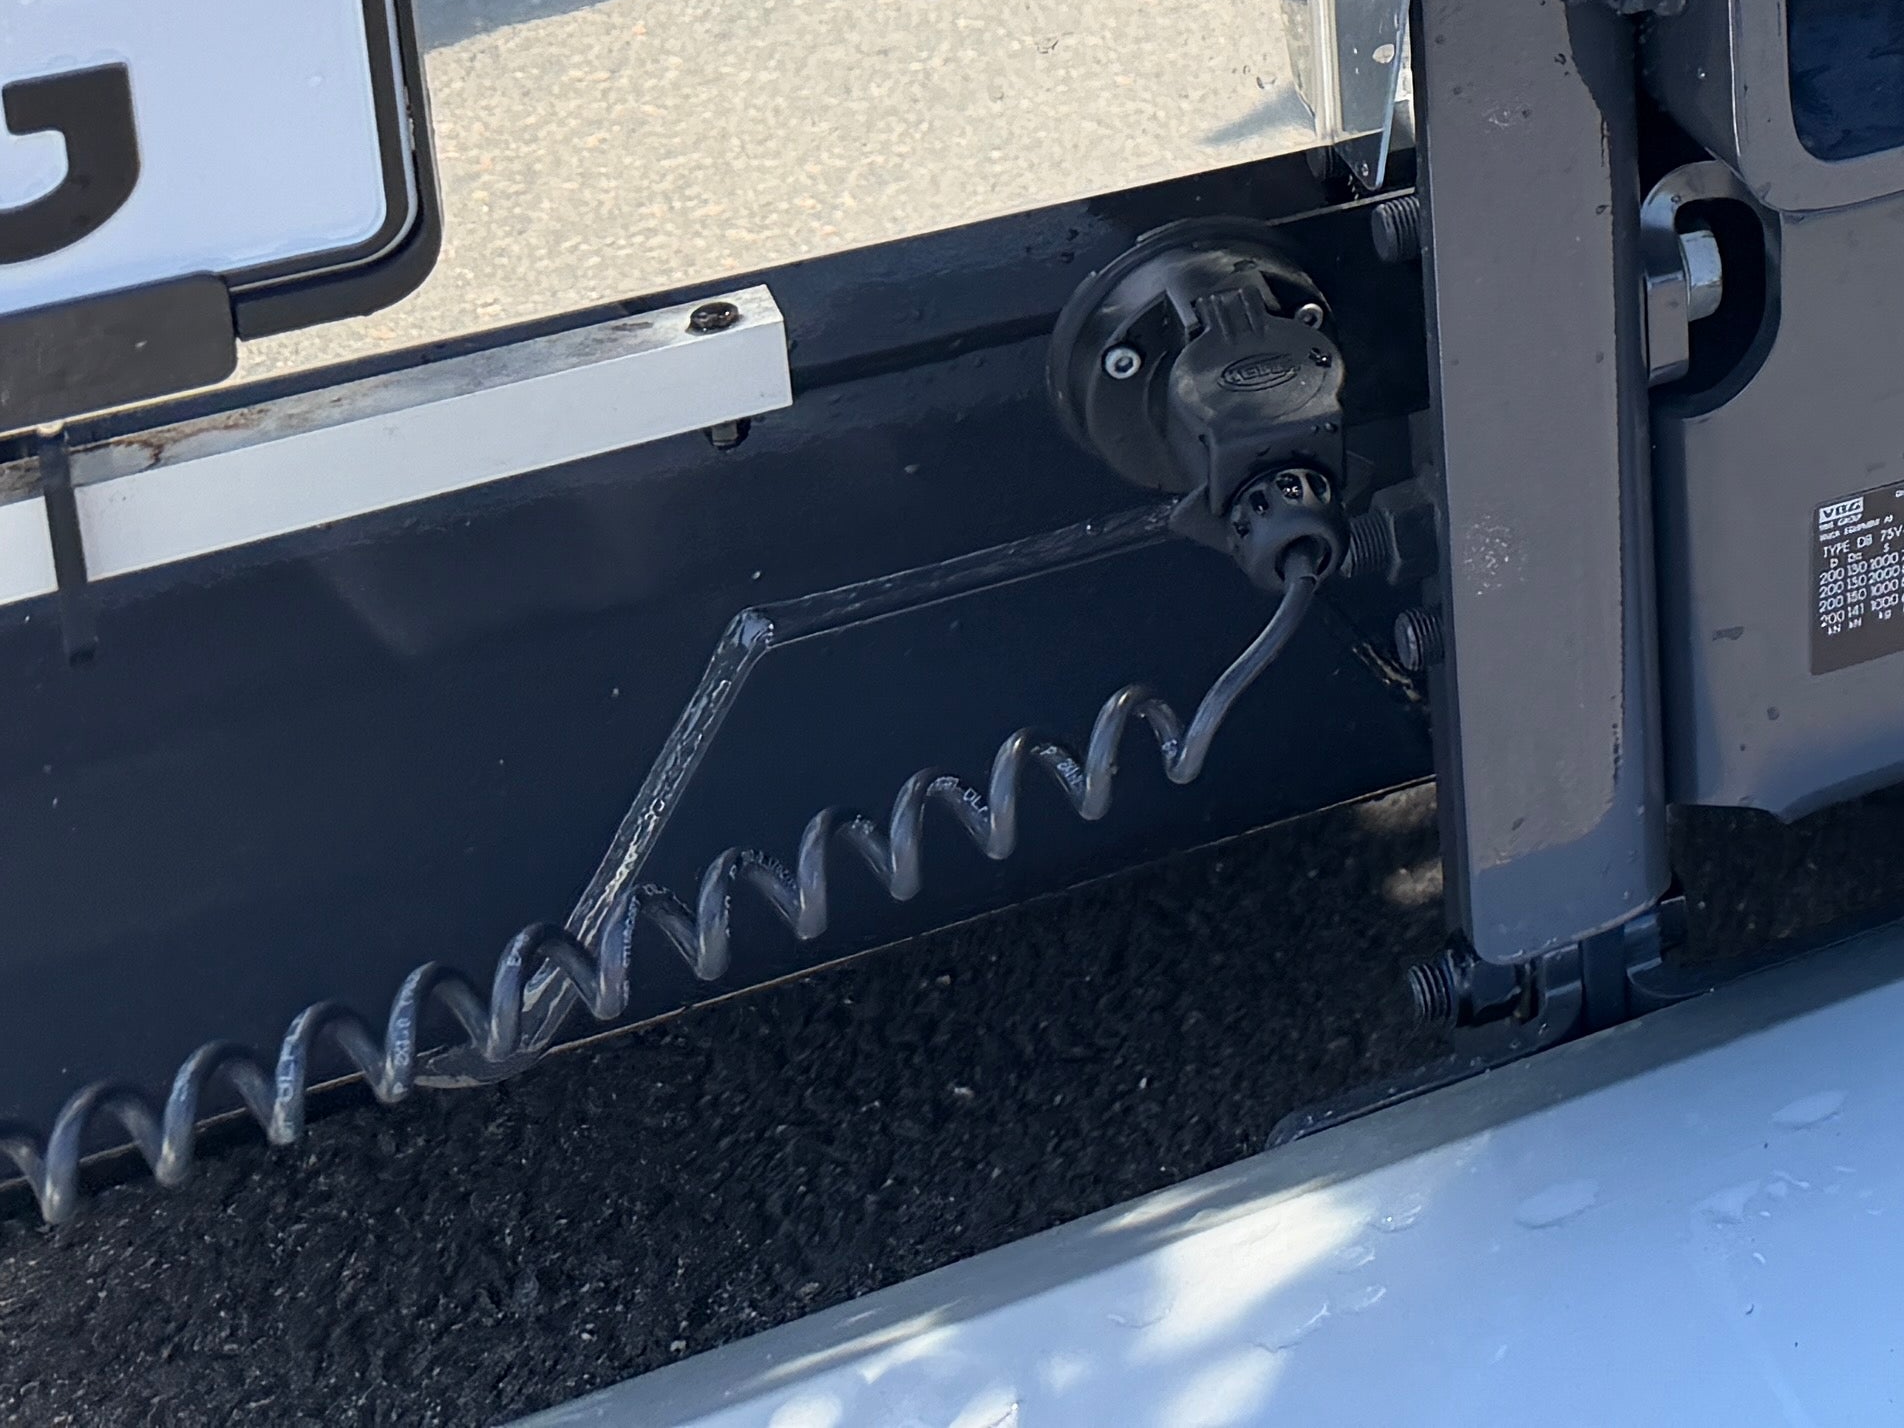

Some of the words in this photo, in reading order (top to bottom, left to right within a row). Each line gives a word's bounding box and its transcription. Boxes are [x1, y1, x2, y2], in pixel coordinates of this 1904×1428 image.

[1823, 540, 1850, 558] TYPE
[1820, 567, 1845, 585] 200
[1820, 581, 1844, 599] 200
[1868, 565, 1900, 584] 2000
[1819, 595, 1844, 613] 200
[1871, 579, 1899, 597] 1000
[1820, 610, 1845, 628] 200
[1847, 602, 1865, 618] 141
[1870, 593, 1899, 611] 1000
